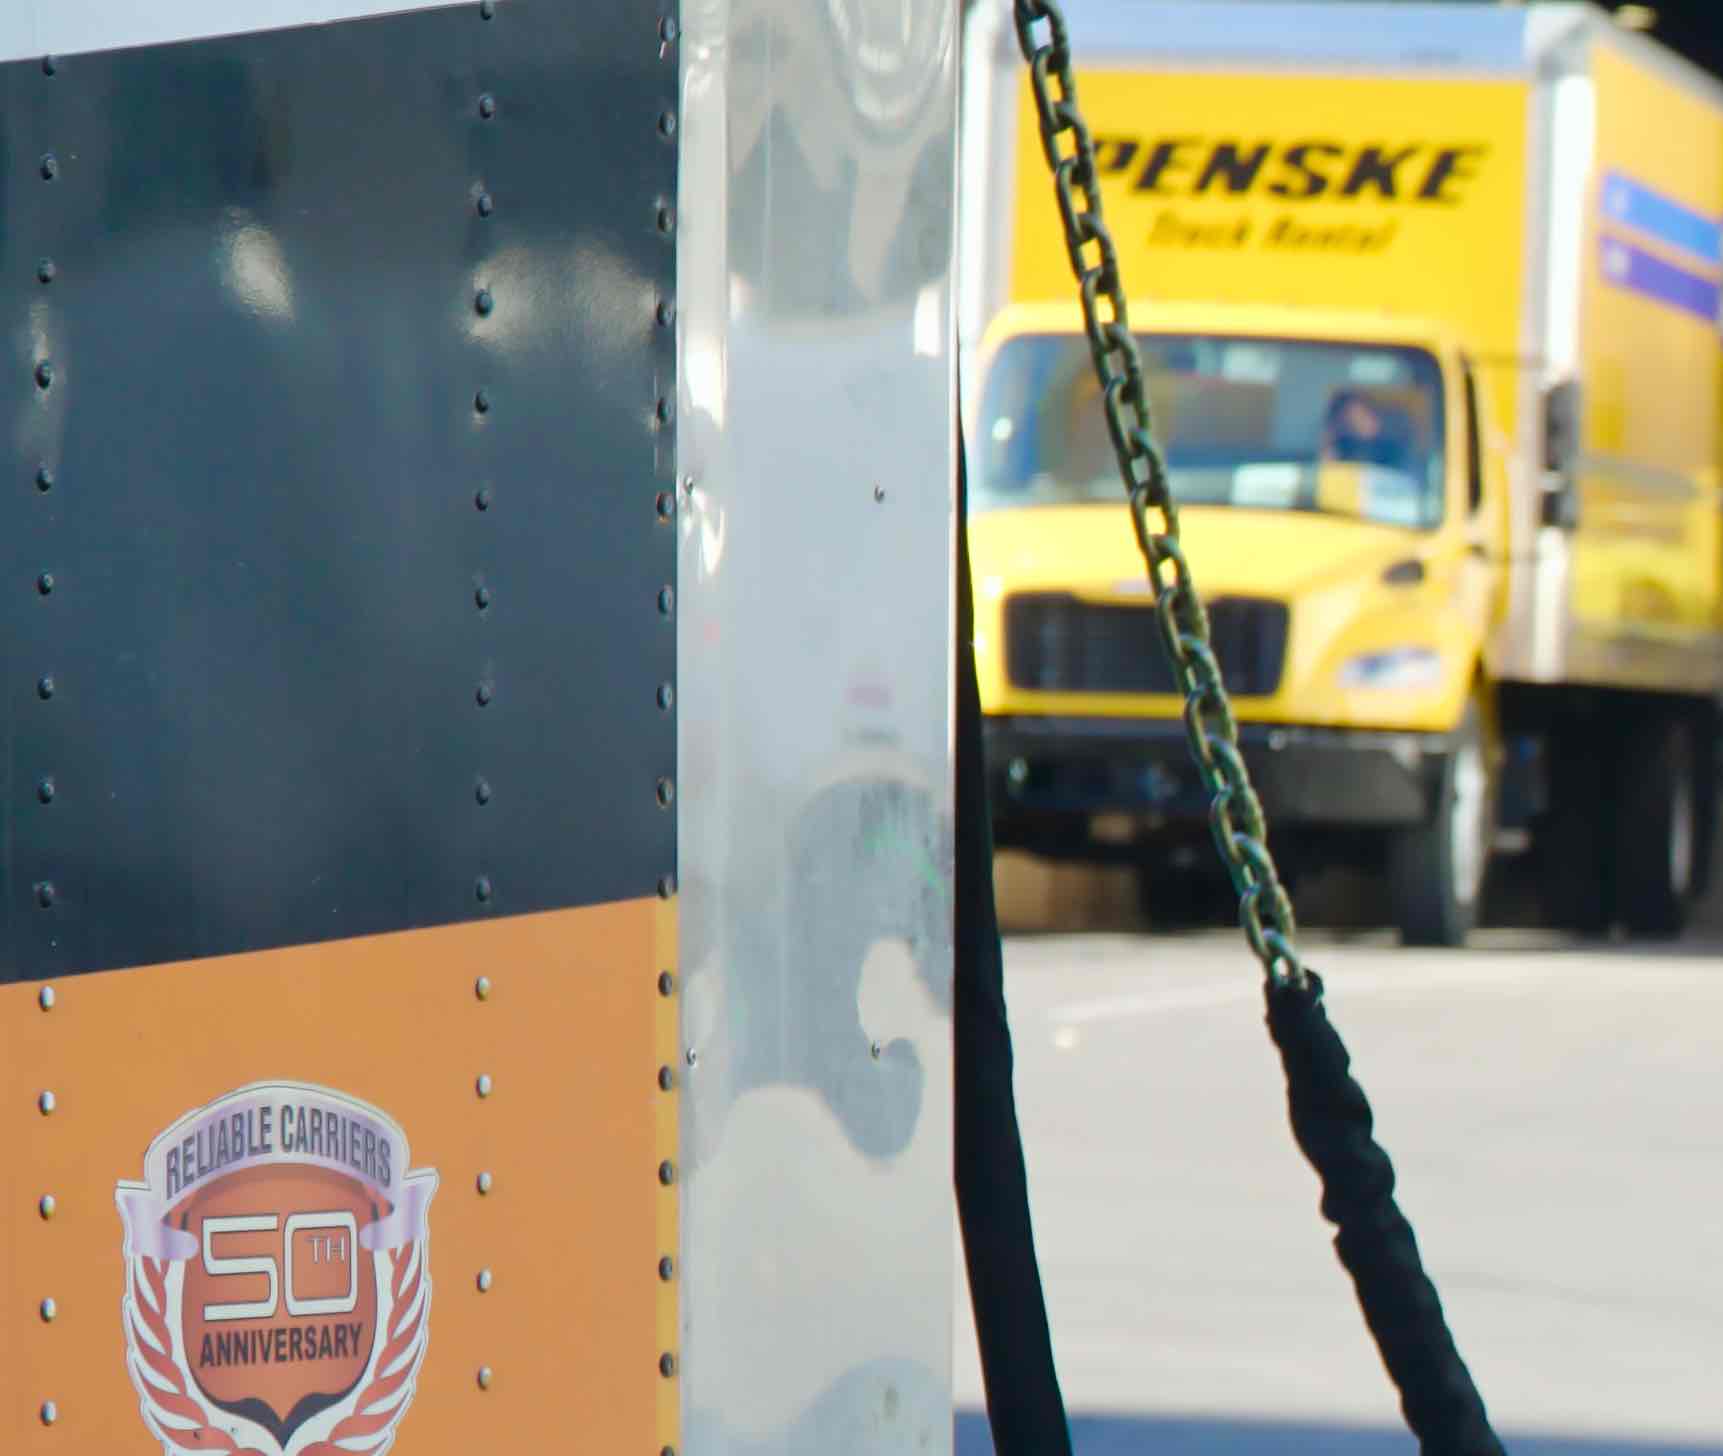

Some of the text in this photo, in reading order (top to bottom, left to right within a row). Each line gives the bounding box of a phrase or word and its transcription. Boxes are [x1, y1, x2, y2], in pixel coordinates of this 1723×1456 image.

[165, 1103, 393, 1202] RELIABLE CARRIERS
[200, 1324, 364, 1369] ANNIVERSARY
